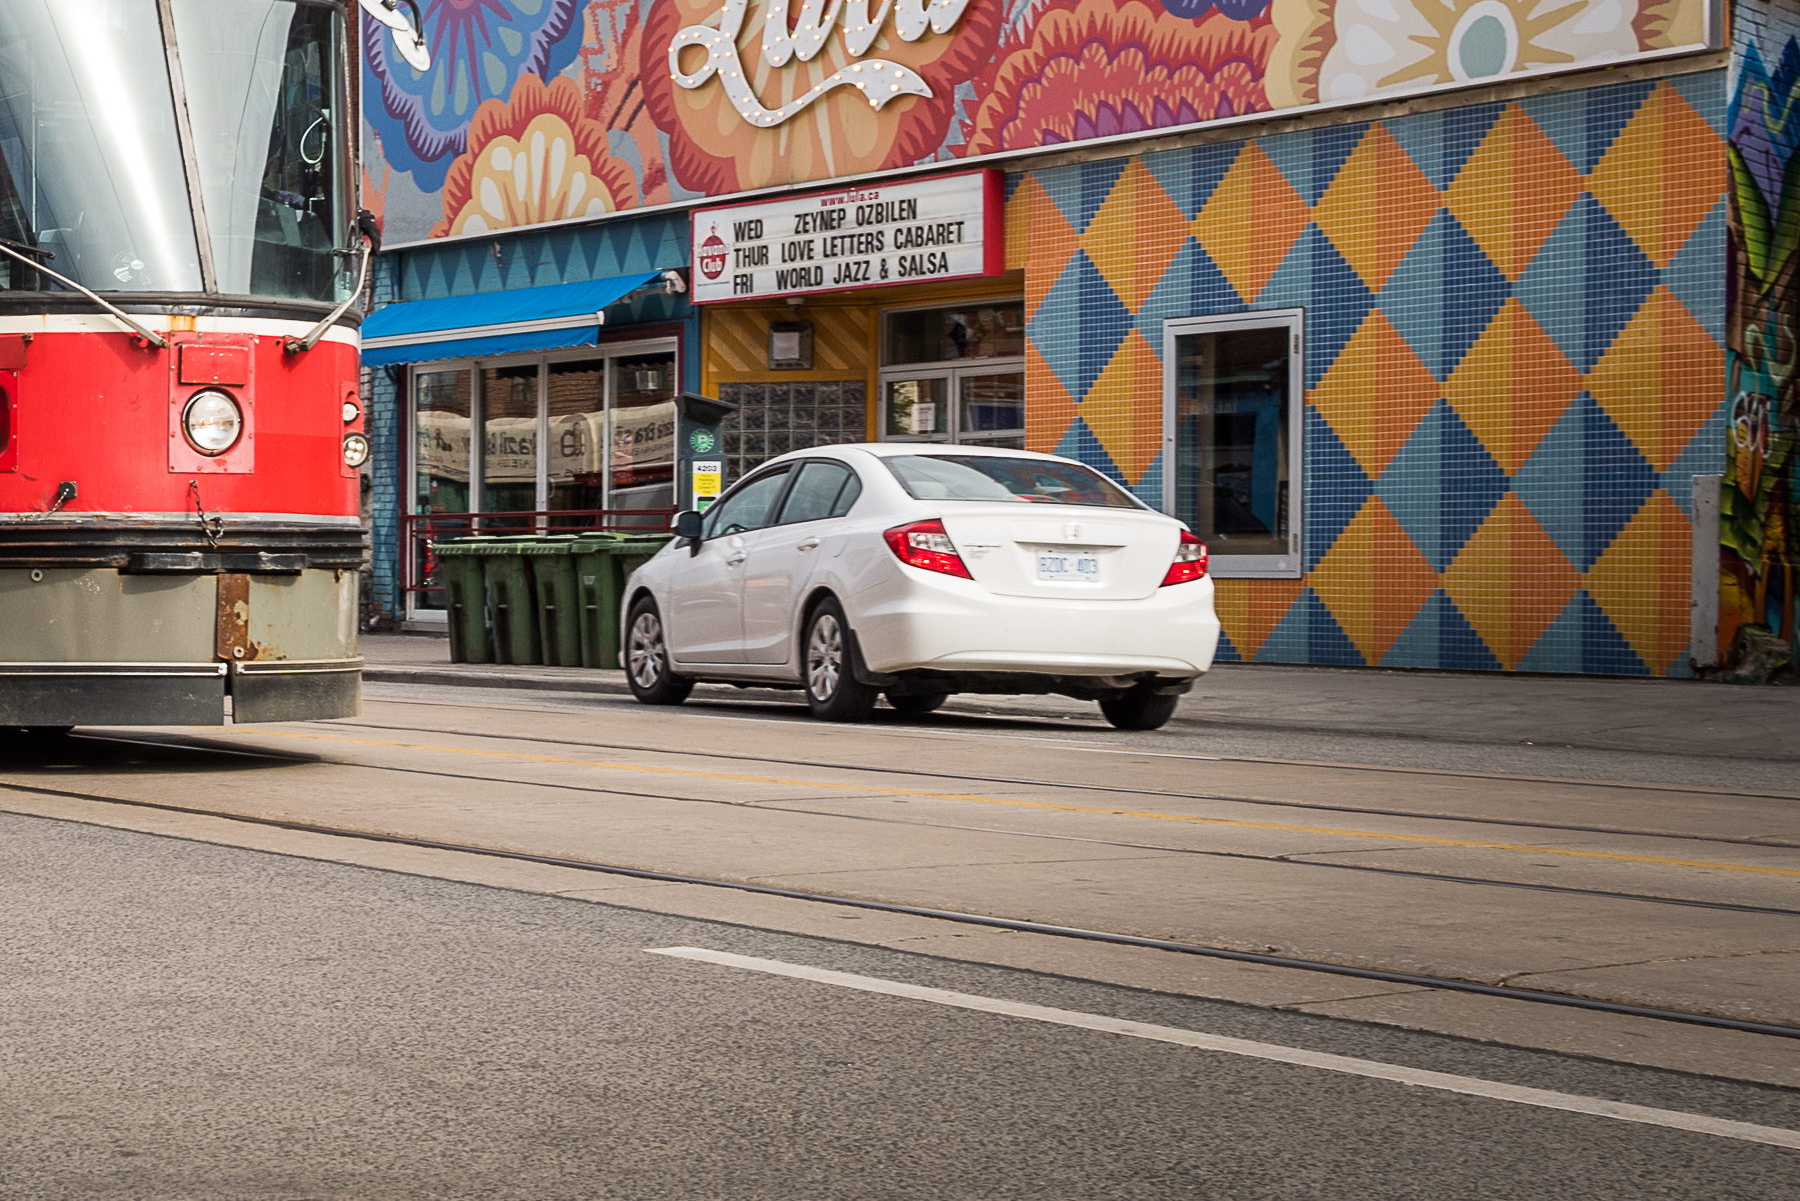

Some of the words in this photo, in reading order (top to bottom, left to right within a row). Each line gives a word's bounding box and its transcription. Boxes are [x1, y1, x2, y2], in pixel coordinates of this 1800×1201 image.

[733, 219, 763, 242] WED
[794, 208, 846, 234] ZEYNEP
[856, 198, 917, 226] OZBILEN
[821, 190, 879, 207] www.lula.ca
[702, 257, 722, 273] Club
[733, 245, 769, 268] THUR
[781, 239, 814, 263] LOVE
[823, 230, 885, 258] LETTERS
[894, 221, 964, 249] CABARET
[733, 273, 753, 295] FRI
[776, 266, 823, 291] WORLD
[833, 260, 871, 285] JAZZ
[879, 258, 889, 280] &
[898, 251, 949, 277] SALSA
